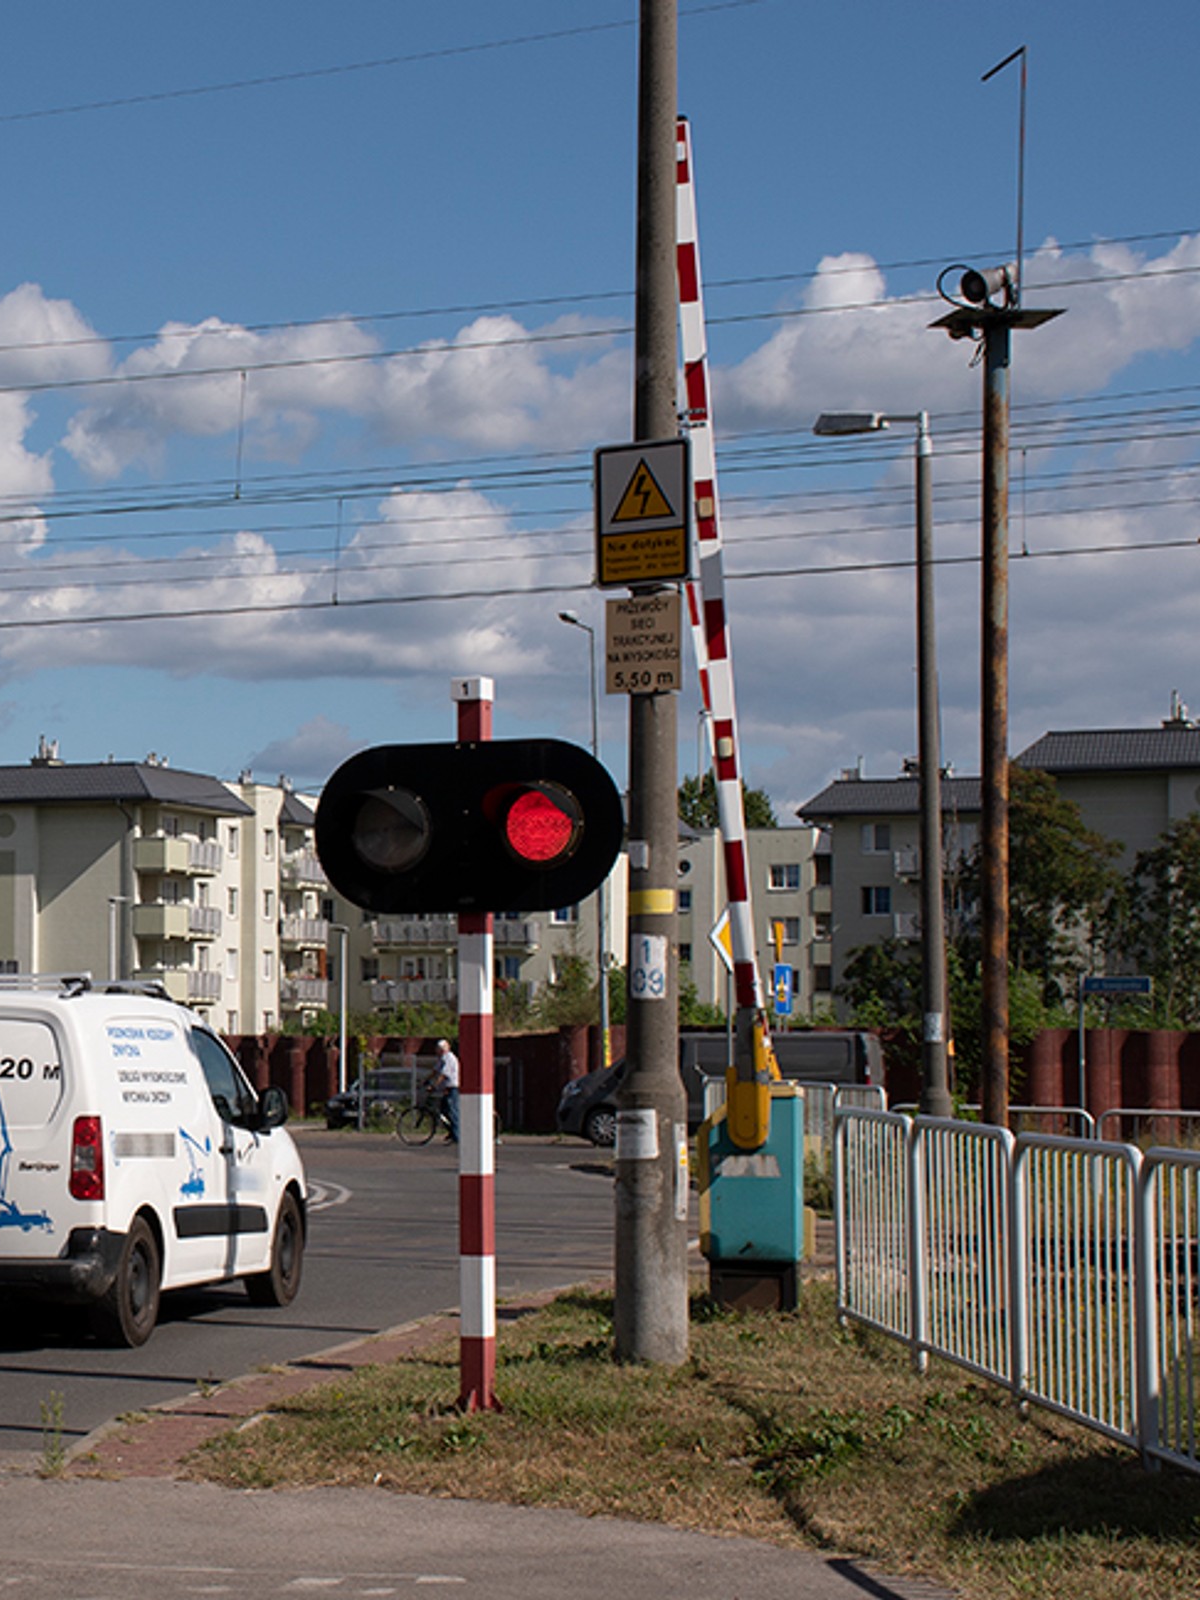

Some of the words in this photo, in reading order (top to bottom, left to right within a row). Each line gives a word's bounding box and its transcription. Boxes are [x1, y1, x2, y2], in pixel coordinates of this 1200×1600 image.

[656, 671, 674, 685] m
[462, 681, 469, 696] 1
[0, 1058, 34, 1080] 20
